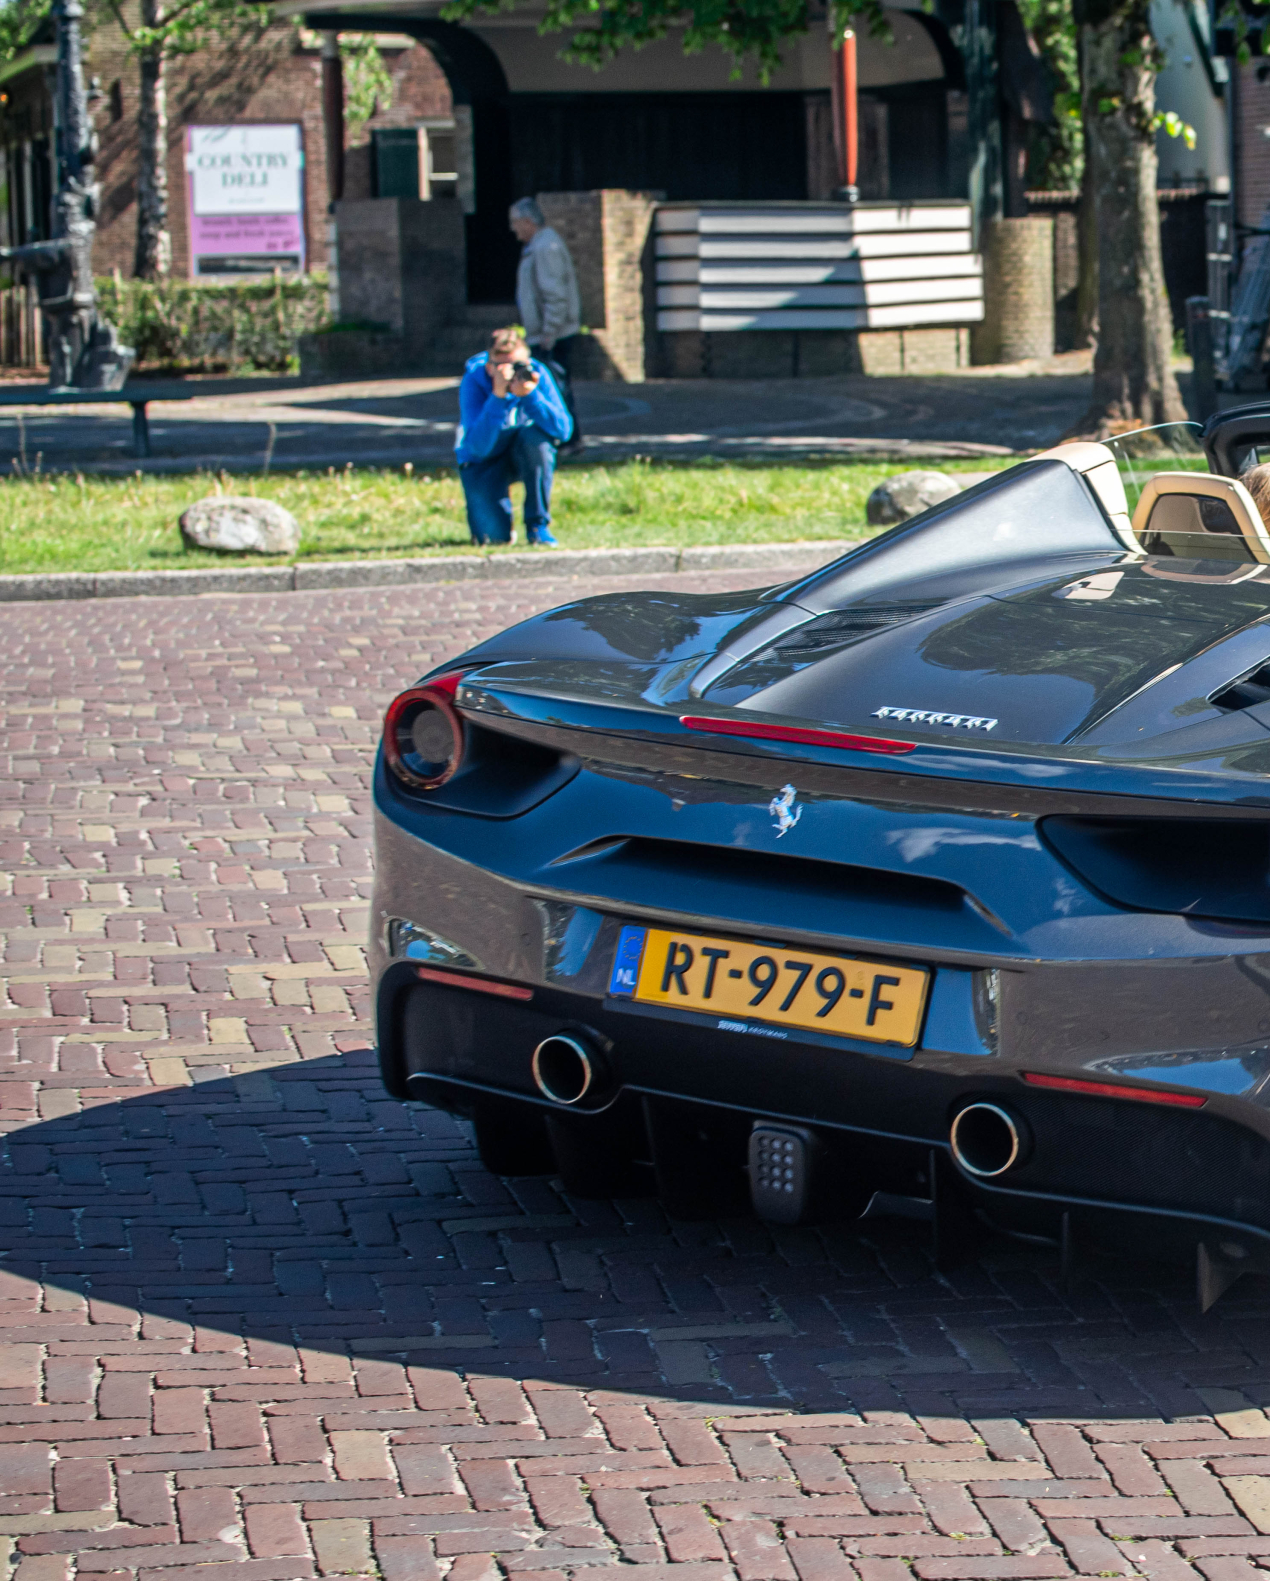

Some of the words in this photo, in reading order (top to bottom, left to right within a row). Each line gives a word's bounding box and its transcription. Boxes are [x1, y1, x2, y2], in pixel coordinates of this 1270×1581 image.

[197, 152, 290, 170] COUNTRY
[221, 171, 269, 187] DELI
[615, 968, 637, 986] NL
[661, 941, 900, 1026] RT-979-F
